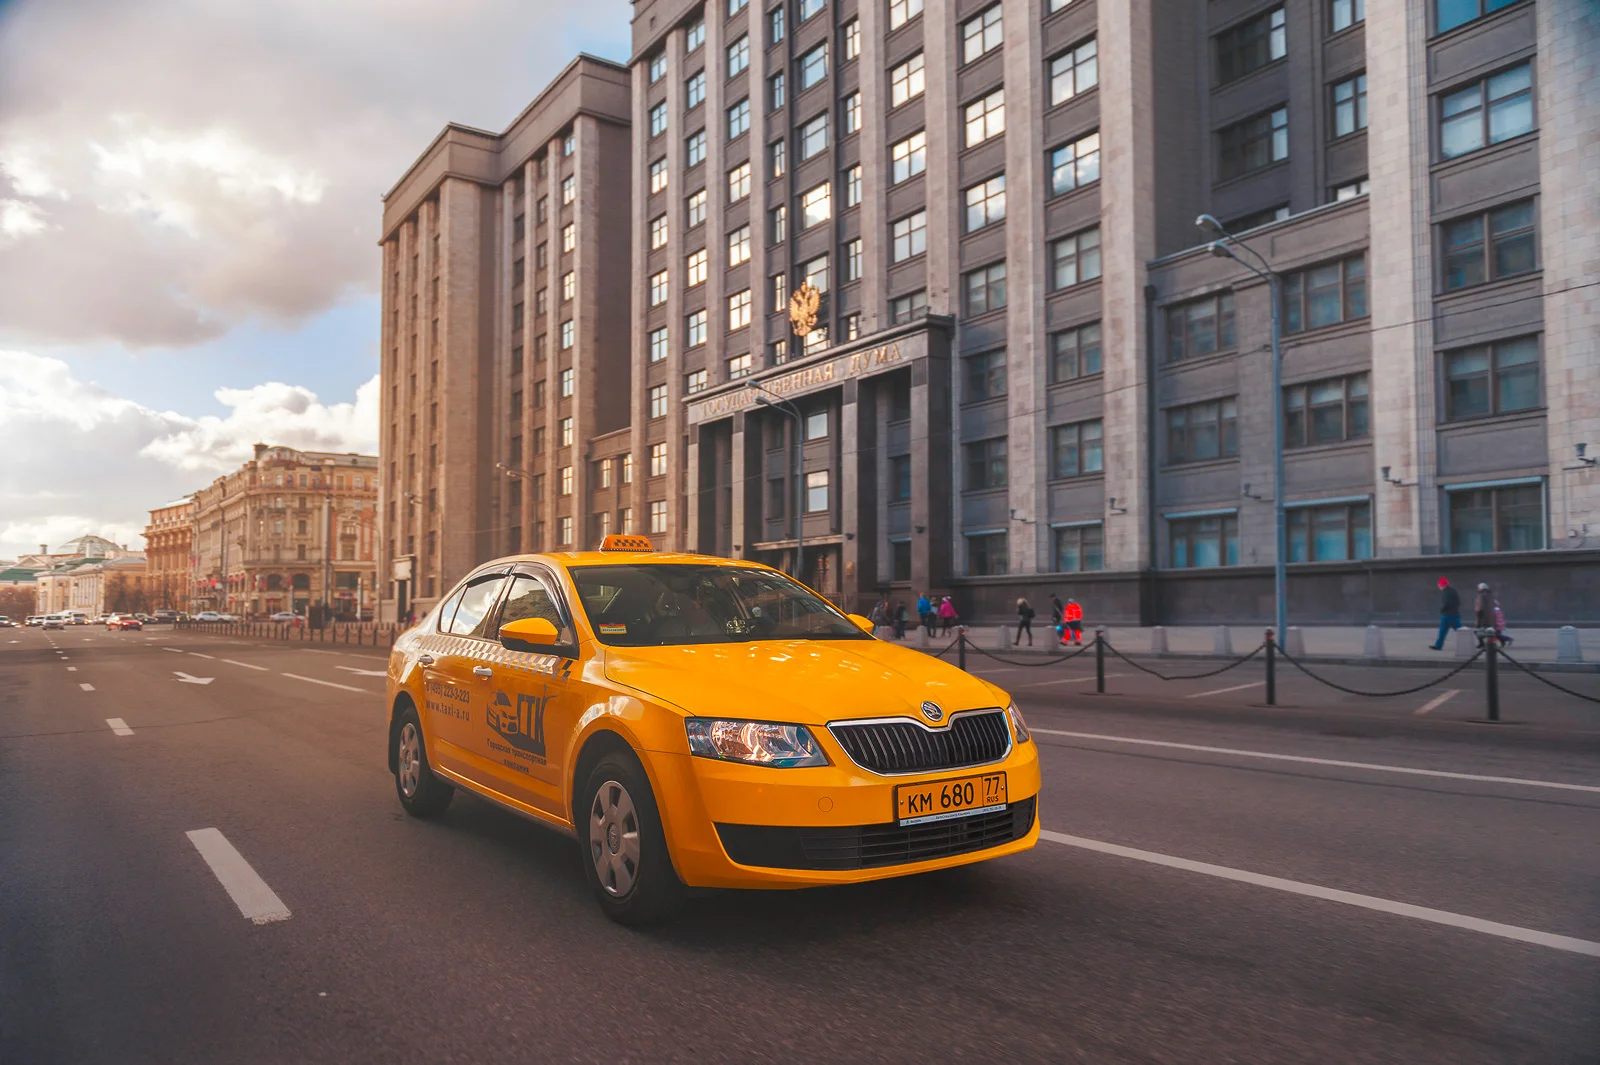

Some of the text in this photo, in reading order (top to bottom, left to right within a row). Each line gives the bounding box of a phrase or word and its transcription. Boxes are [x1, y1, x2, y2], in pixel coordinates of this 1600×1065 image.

[849, 343, 902, 376] ДУМА
[443, 685, 470, 704] 223-3-223
[426, 700, 470, 721] www.taxi-a.ru
[940, 781, 975, 809] 680
[984, 776, 1000, 796] 77
[986, 795, 999, 803] RUS
